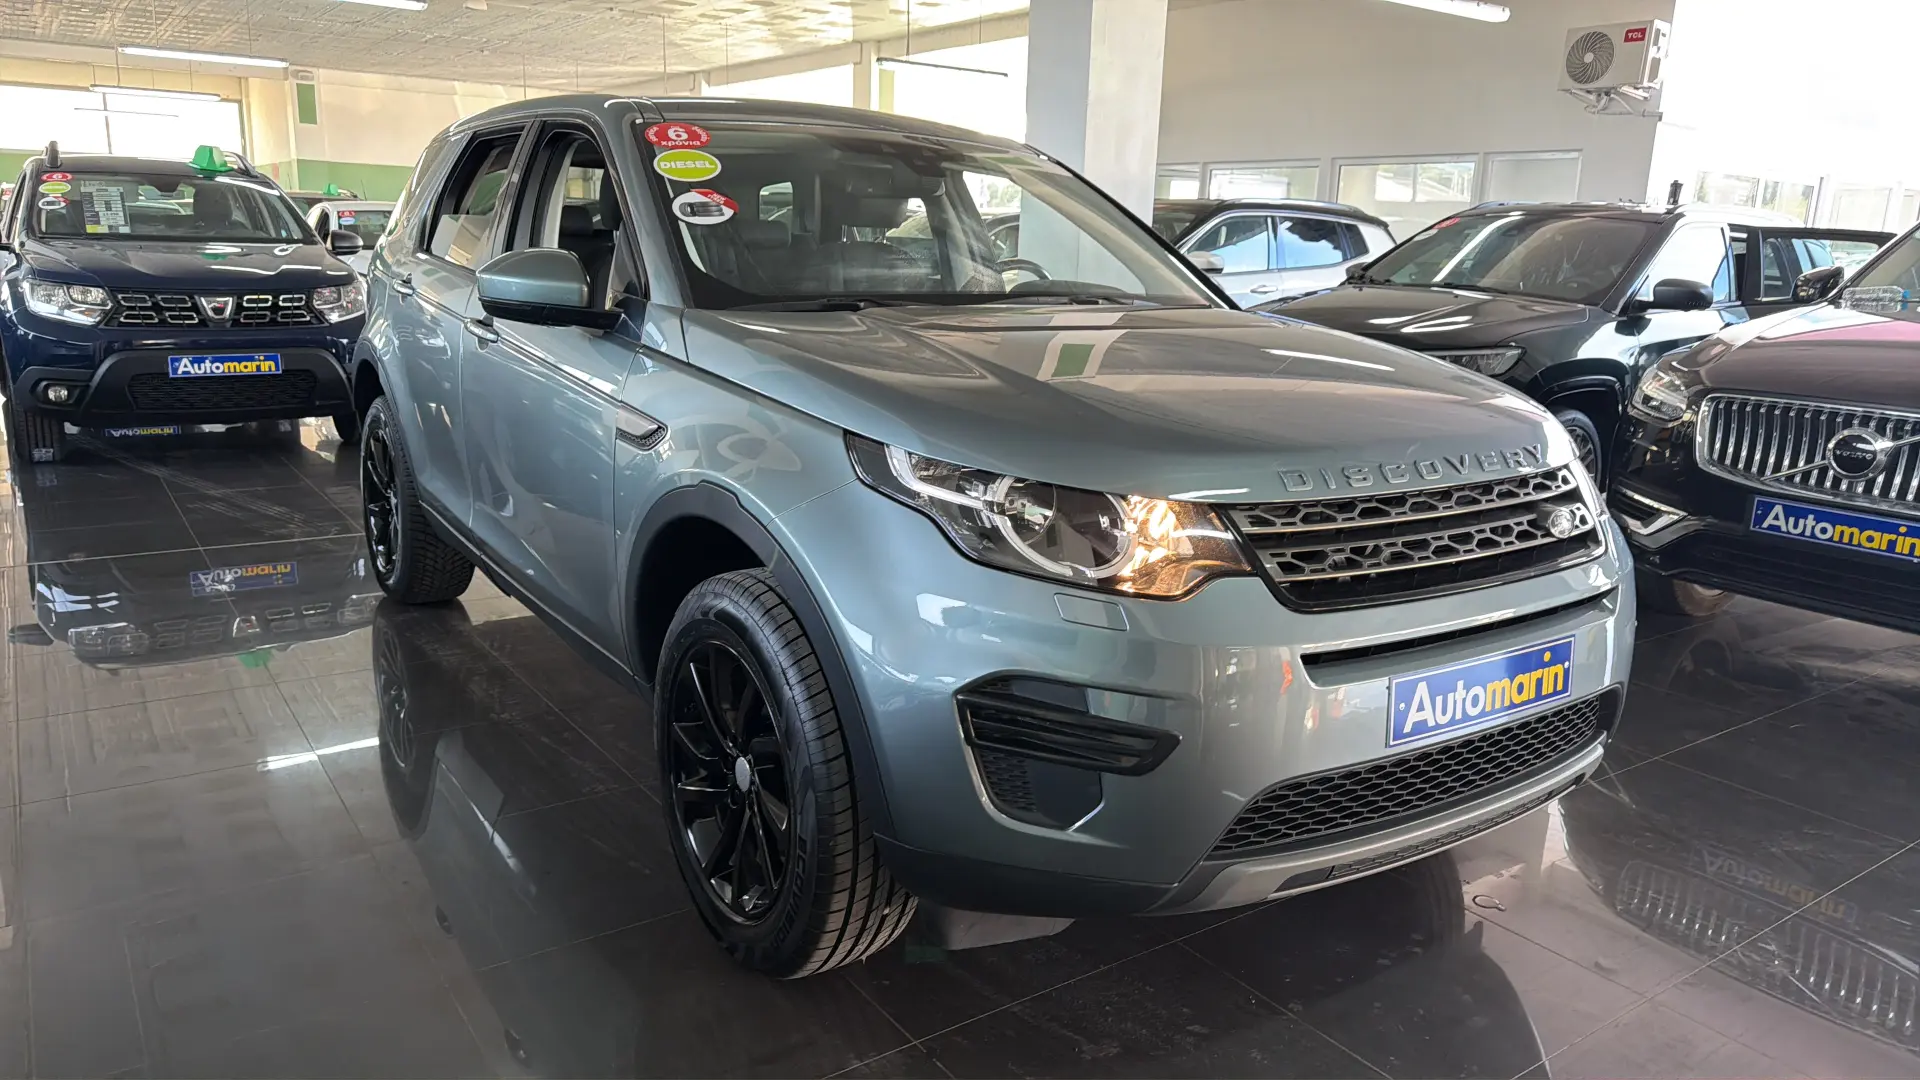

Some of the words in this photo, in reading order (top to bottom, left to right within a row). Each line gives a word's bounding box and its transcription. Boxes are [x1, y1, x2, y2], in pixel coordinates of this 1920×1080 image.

[668, 128, 688, 140] 6
[176, 356, 276, 375] Automarin
[1280, 443, 1544, 492] DISCOVERY
[1835, 450, 1873, 460] VOLVO
[1762, 505, 1920, 556] Automarin
[1404, 651, 1564, 733] Automarin
